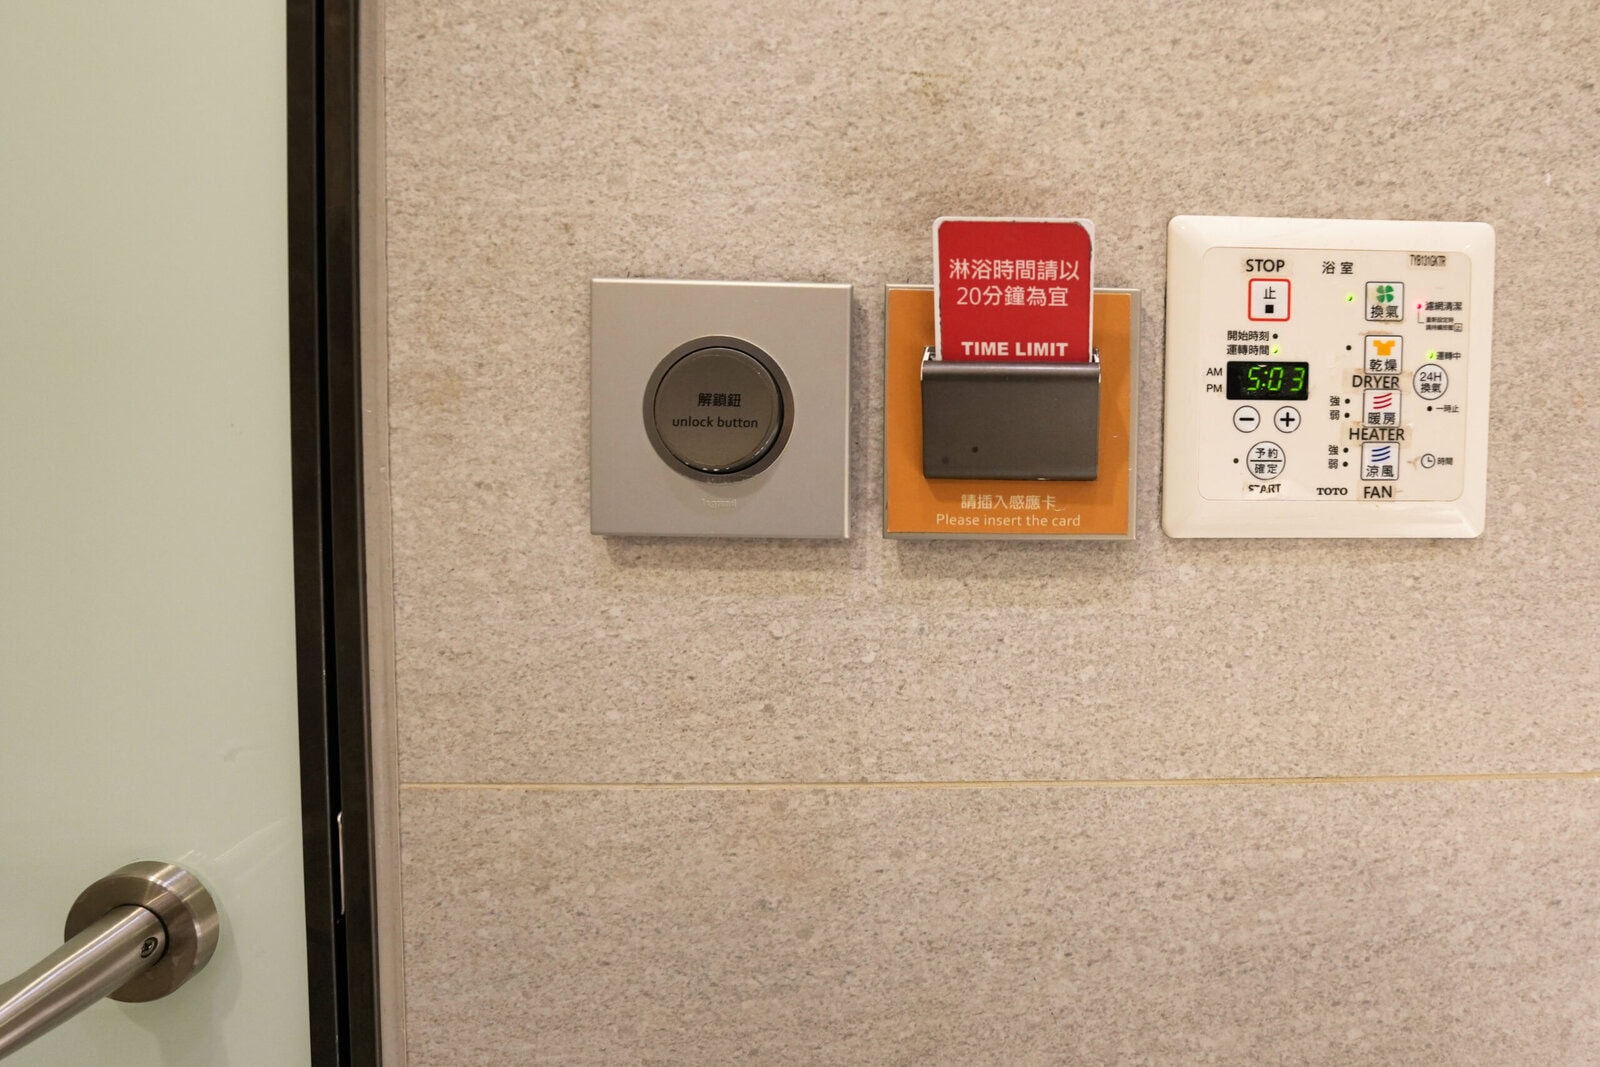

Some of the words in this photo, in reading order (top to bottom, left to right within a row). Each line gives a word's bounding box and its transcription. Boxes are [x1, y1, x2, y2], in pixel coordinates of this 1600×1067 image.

[948, 258, 1080, 282] 淋浴時間請以
[1245, 258, 1285, 272] STOP
[1321, 260, 1354, 275] 浴室
[956, 285, 1069, 307] 20分鐘為宜
[1263, 285, 1277, 300] 止
[1370, 305, 1399, 319] 換氣
[1226, 330, 1270, 342] 開始時刻
[961, 341, 1009, 356] TIME
[1015, 342, 1069, 357] LIMIT
[1226, 344, 1270, 356] 運轉時間
[1206, 367, 1223, 377] AM
[1369, 358, 1398, 372] 乾燥
[1247, 366, 1306, 392] 5:03
[1352, 374, 1400, 389] DRYER
[1419, 371, 1442, 382] 24H
[1206, 384, 1223, 393] PM
[1420, 383, 1442, 394] 換氣
[697, 392, 742, 408] 解鎖鈕
[672, 416, 714, 428] unlock
[716, 416, 759, 429] button
[1367, 411, 1396, 425] 暖房
[1349, 427, 1405, 441] HEATER
[1254, 463, 1278, 475] 確定
[1365, 465, 1394, 478] 涼風
[1316, 487, 1349, 496] TOTO
[1363, 485, 1393, 499] FAN
[960, 494, 1057, 510] 請插入感應卡
[936, 513, 980, 526] Please
[983, 514, 1021, 527] insert
[1024, 514, 1048, 527] the
[1051, 514, 1081, 528] card
